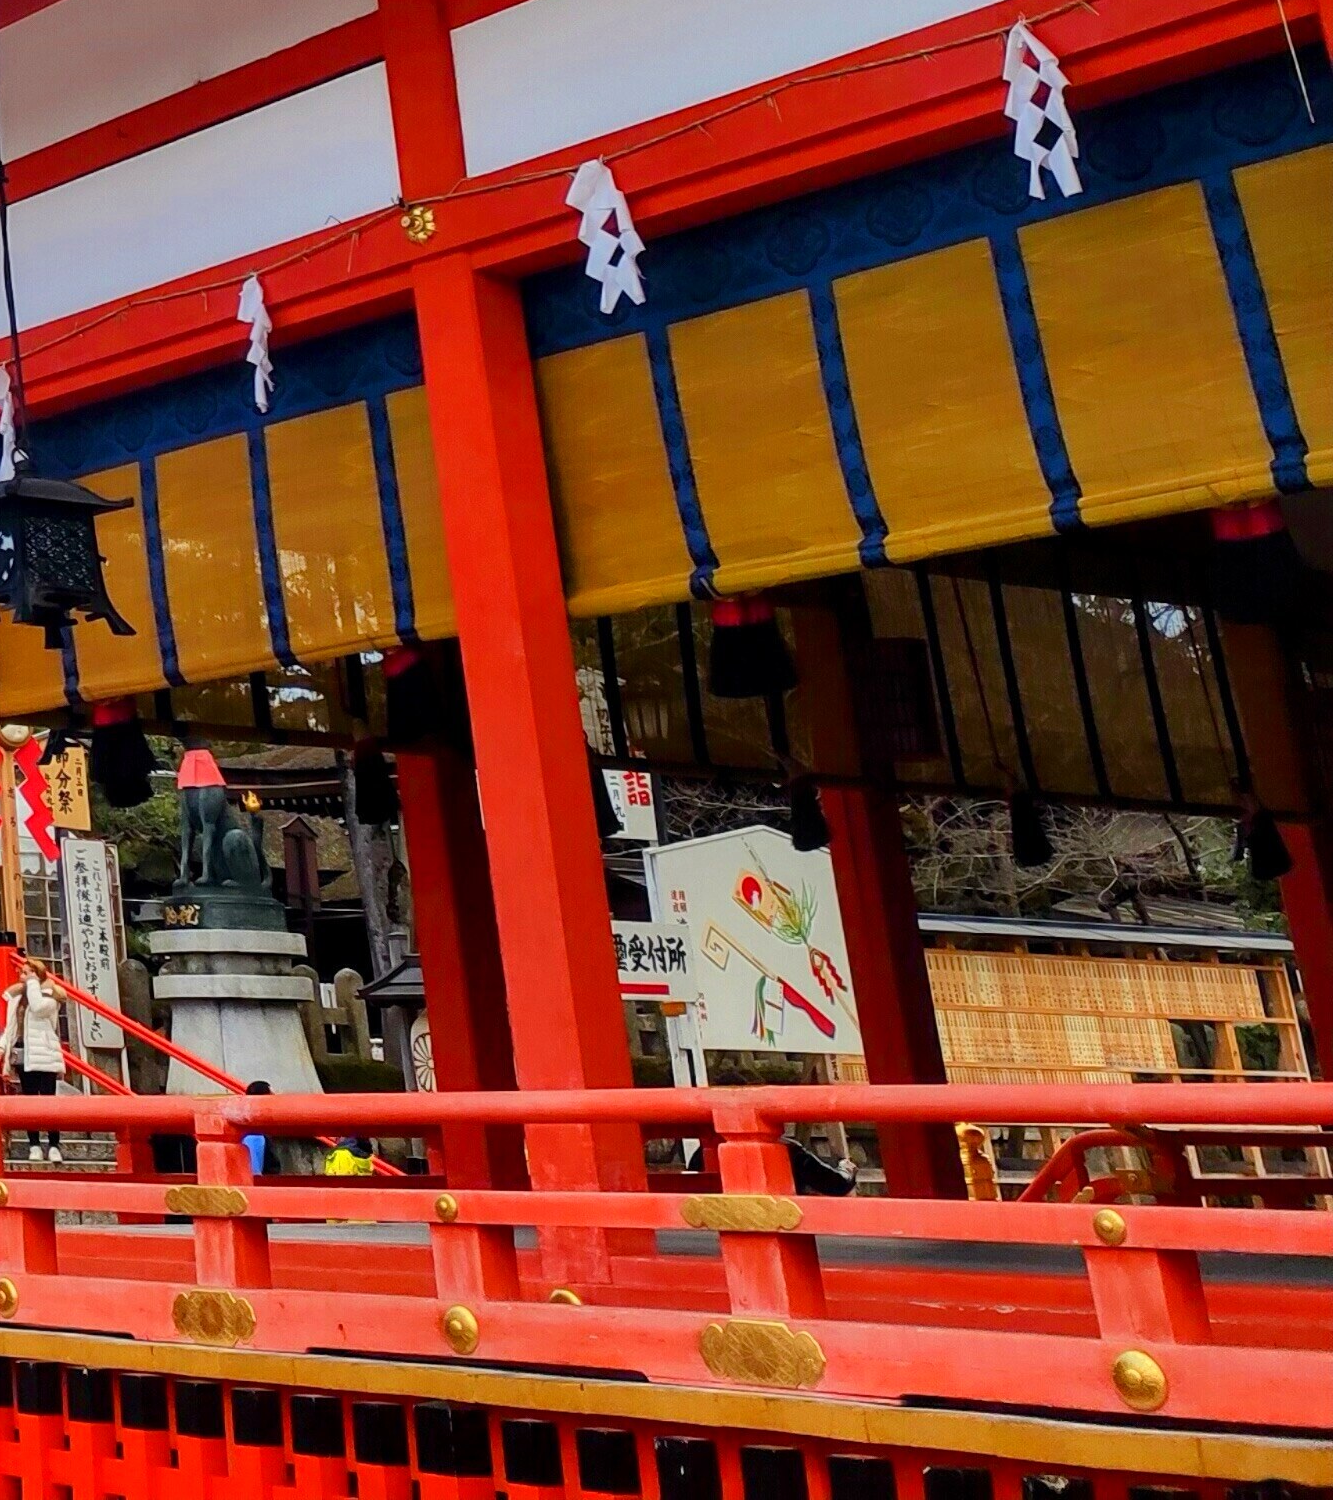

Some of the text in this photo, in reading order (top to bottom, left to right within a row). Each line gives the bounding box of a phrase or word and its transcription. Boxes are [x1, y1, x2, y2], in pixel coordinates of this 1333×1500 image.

[74, 849, 103, 1042] ご参拝後は速やかにおゆずさい
